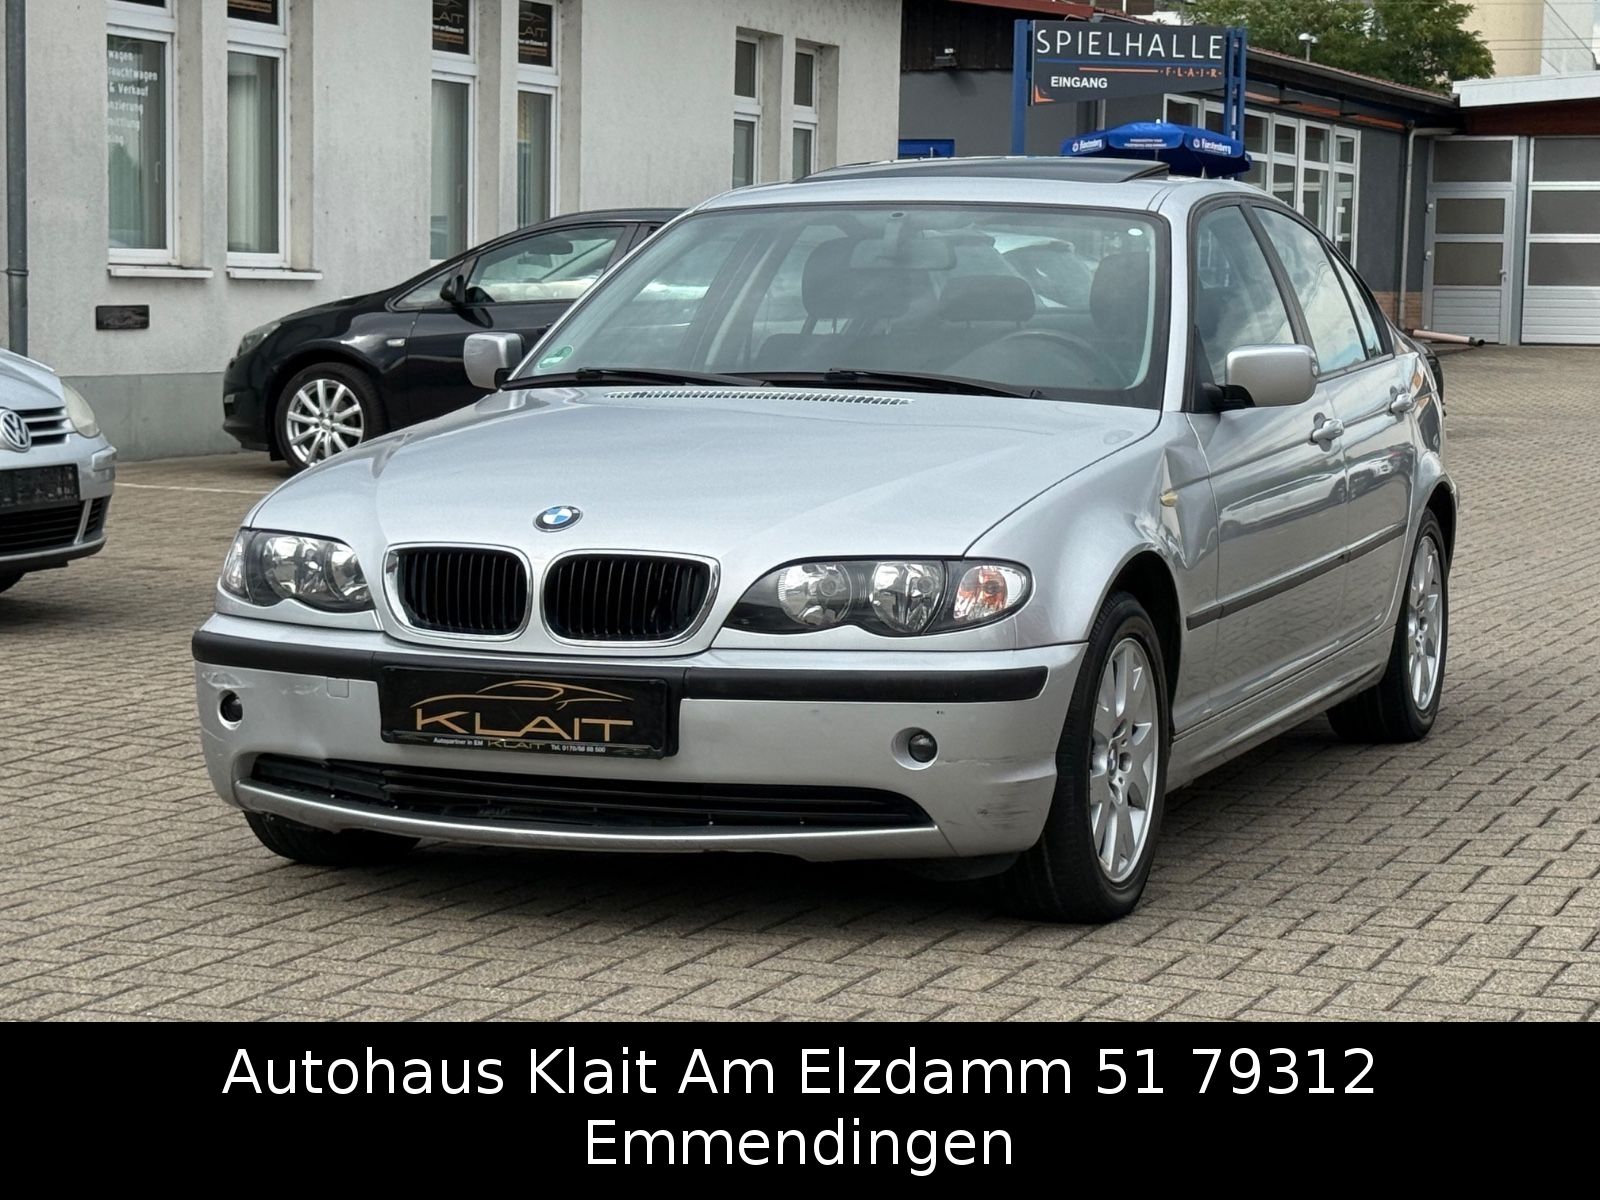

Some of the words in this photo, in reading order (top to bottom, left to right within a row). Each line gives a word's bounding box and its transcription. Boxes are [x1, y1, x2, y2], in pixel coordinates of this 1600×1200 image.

[1036, 29, 1223, 59] SPIELHALLE
[1050, 76, 1108, 89] EINGANG
[118, 83, 149, 97] Verkauf
[416, 708, 634, 742] KLAIT
[488, 740, 545, 750] KLAIT
